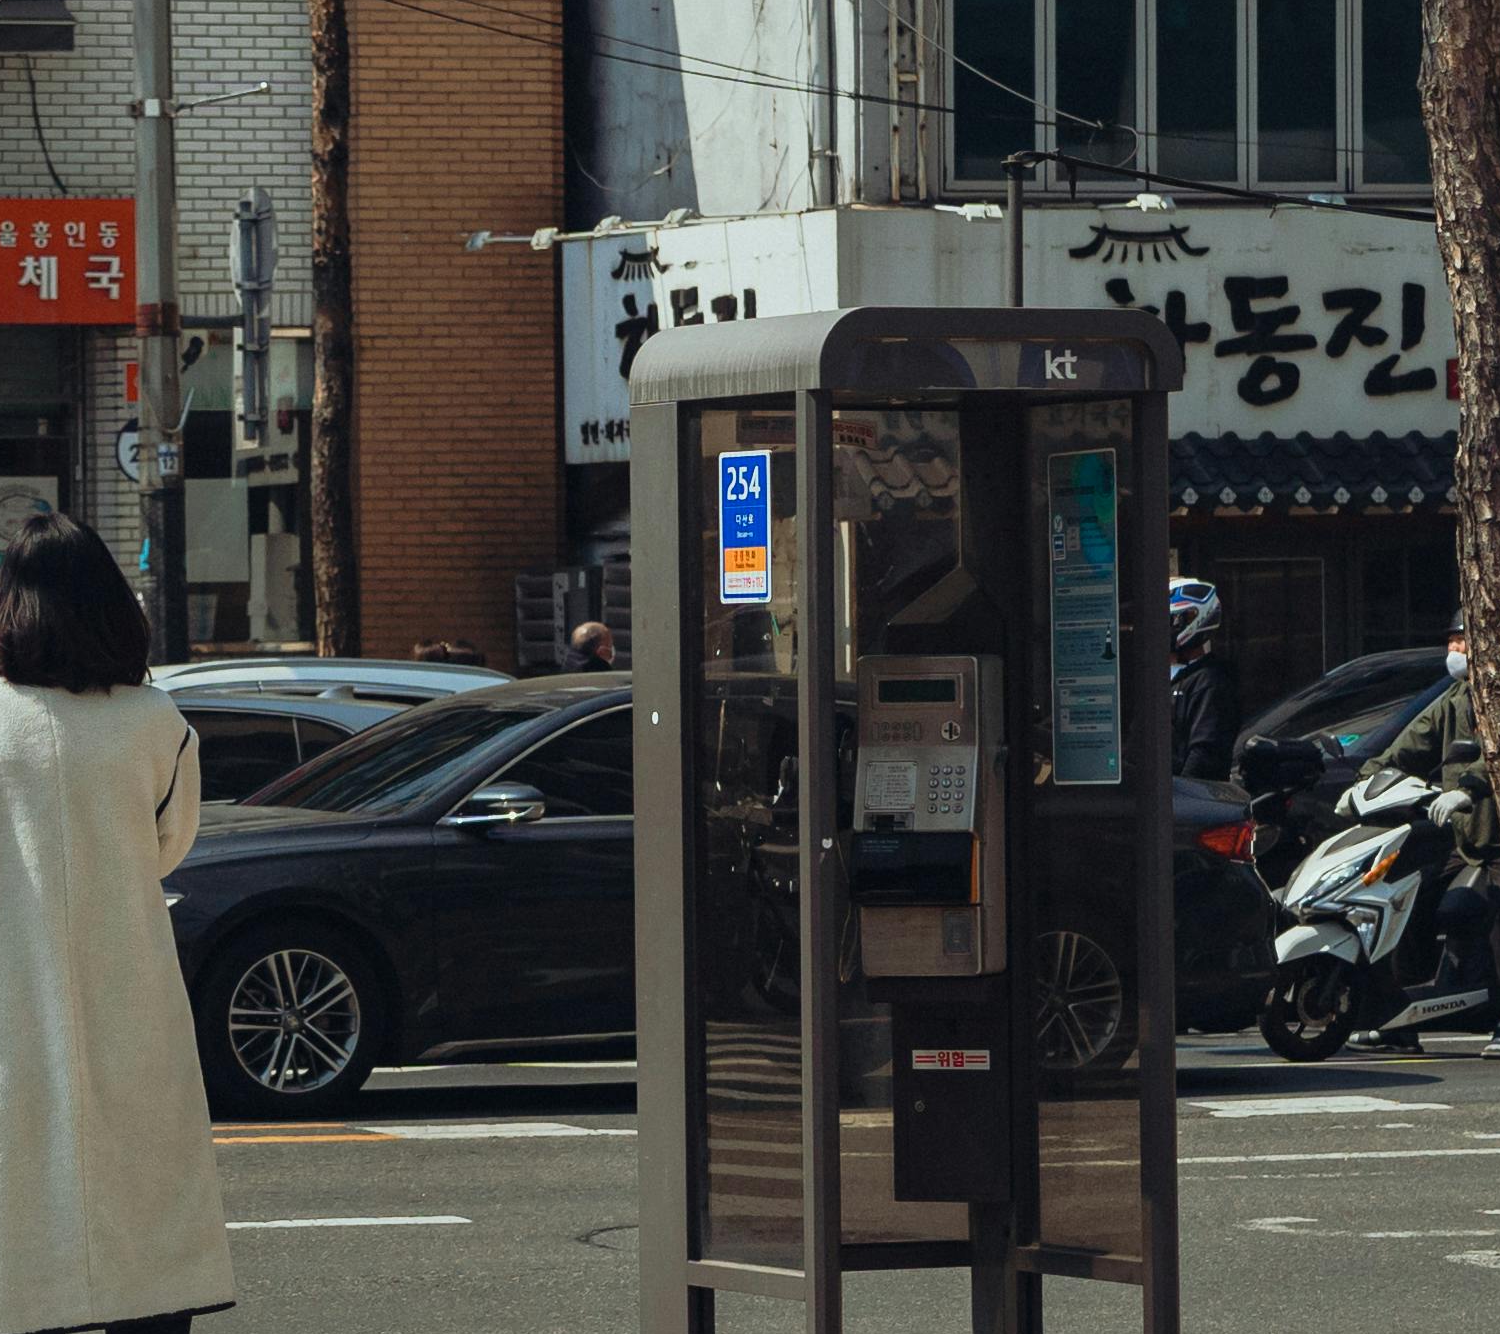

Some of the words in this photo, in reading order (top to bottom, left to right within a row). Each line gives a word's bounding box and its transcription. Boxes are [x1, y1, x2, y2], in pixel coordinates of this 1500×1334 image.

[1045, 349, 1077, 380] kt
[727, 465, 761, 501] 254
[1421, 999, 1466, 1015] HONDA
[937, 1050, 966, 1069] 위험
